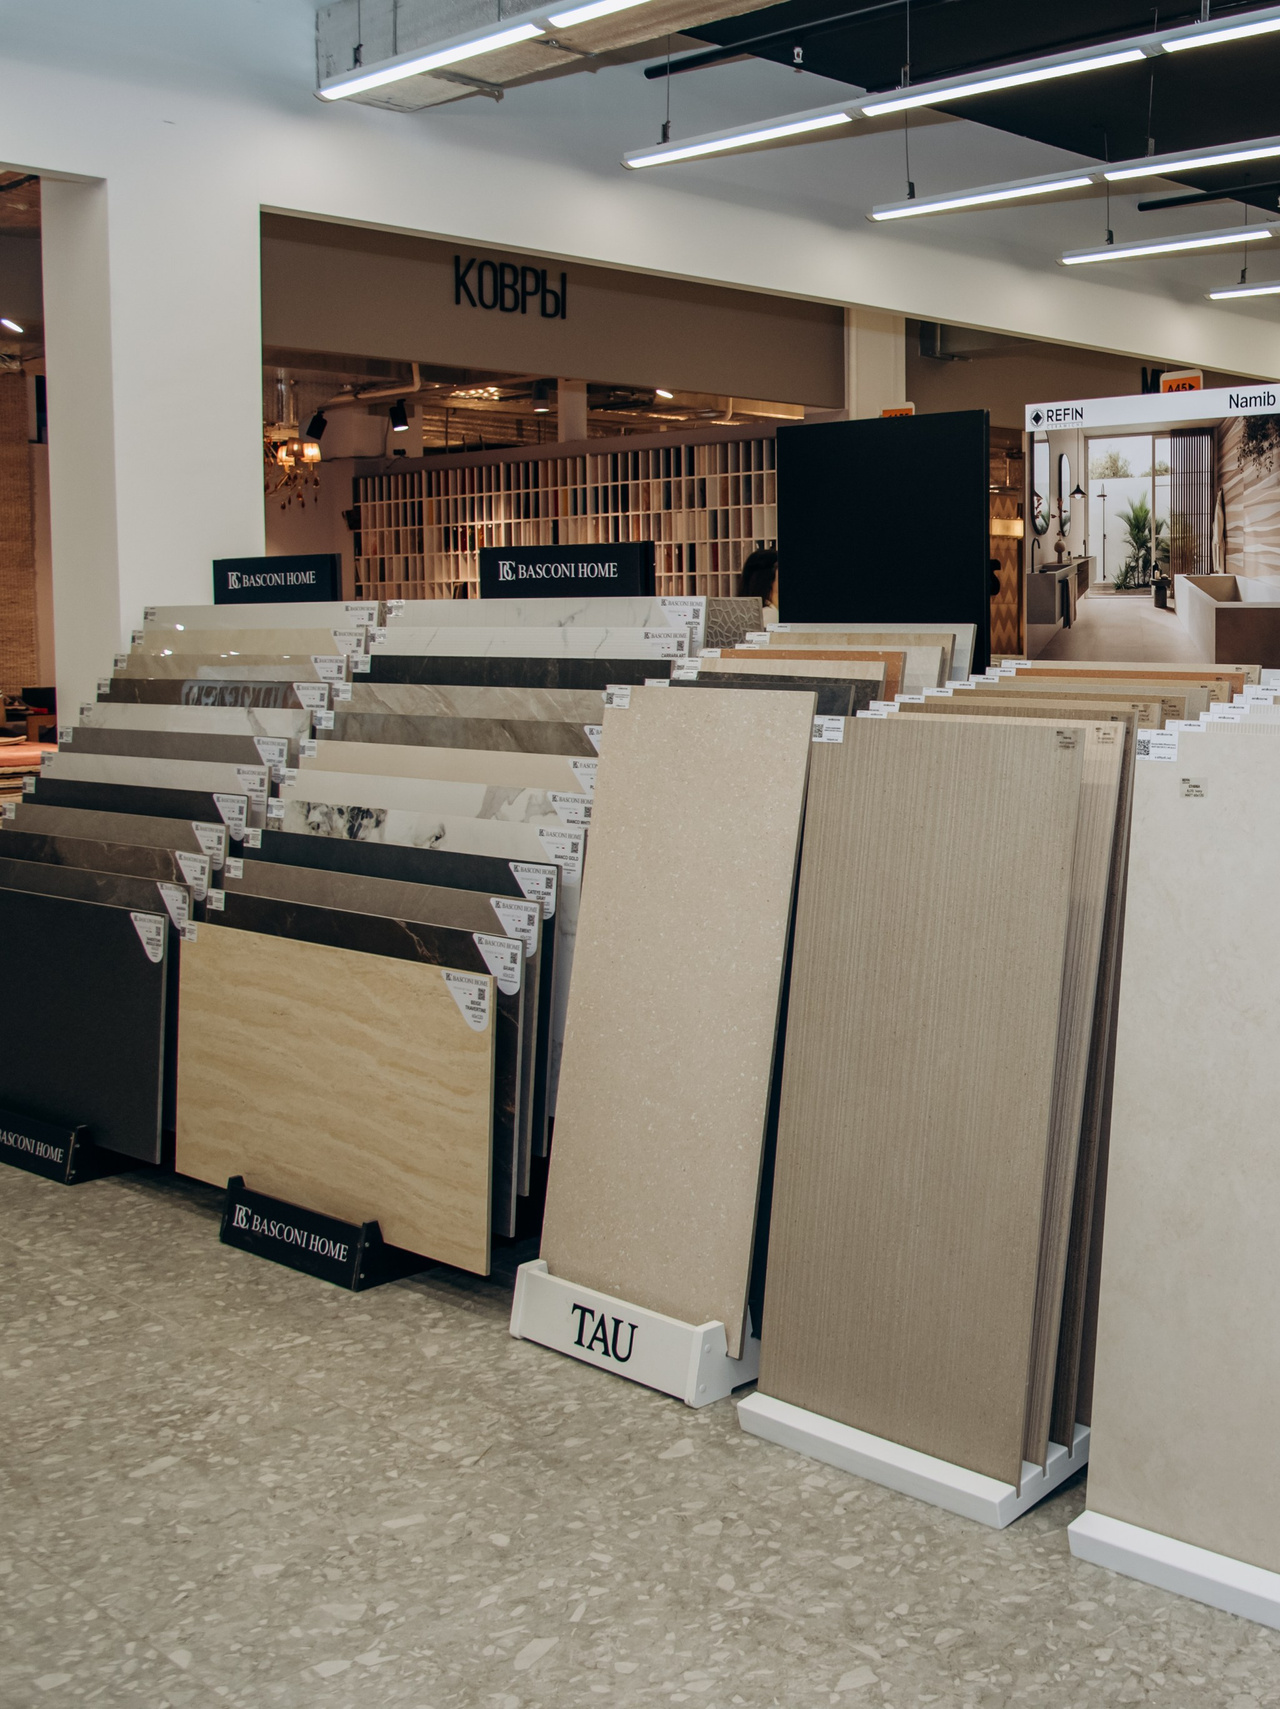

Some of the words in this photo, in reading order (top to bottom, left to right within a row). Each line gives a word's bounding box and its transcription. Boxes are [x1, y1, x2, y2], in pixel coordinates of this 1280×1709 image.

[454, 255, 567, 319] КОВРЫ
[1228, 391, 1277, 409] Namib
[1046, 407, 1084, 422] REFIN
[518, 563, 575, 579] BASCONI
[578, 562, 618, 578] HOME
[243, 573, 285, 588] BASCONI
[286, 571, 316, 585] HOME
[502, 902, 524, 911] BASCONI
[485, 939, 506, 948] BASCONI
[506, 943, 520, 951] HOME
[452, 975, 474, 985] BASCONI
[35, 1141, 64, 1163] HOME
[252, 1214, 308, 1248] BASCONI
[308, 1234, 349, 1262] HOME
[571, 1302, 639, 1363] TAU
